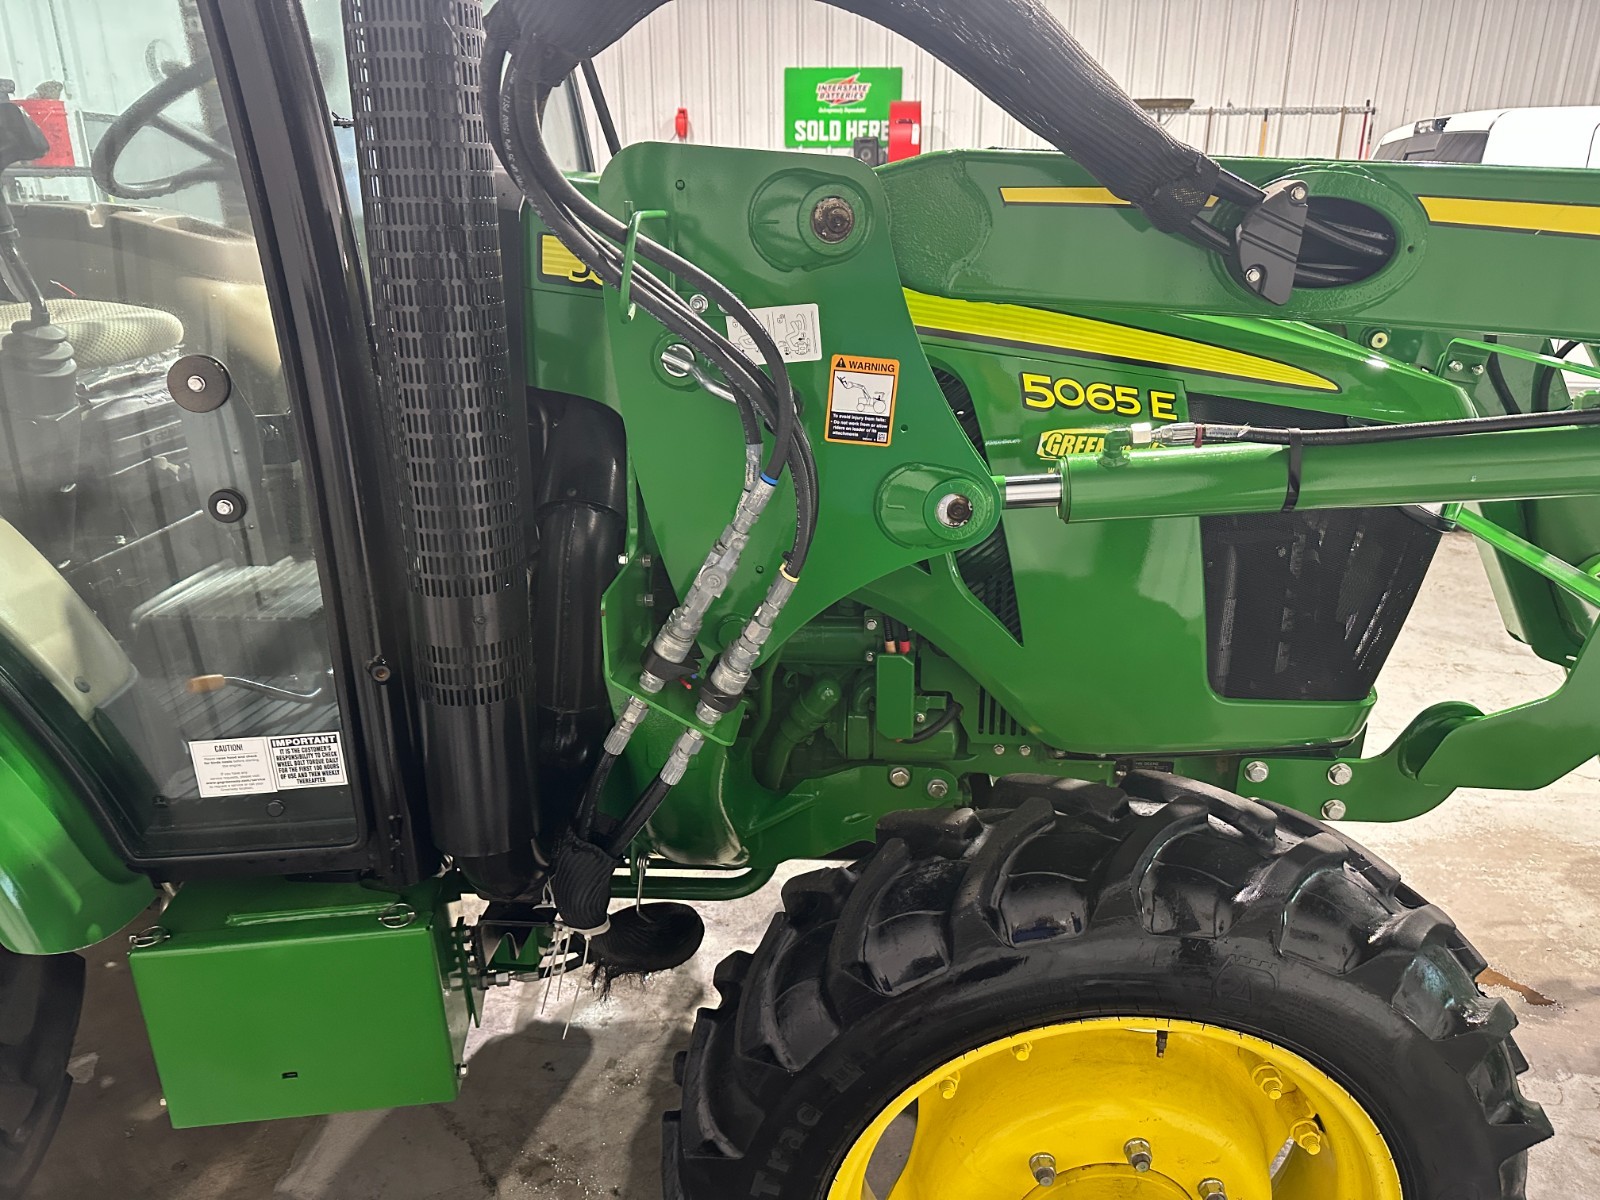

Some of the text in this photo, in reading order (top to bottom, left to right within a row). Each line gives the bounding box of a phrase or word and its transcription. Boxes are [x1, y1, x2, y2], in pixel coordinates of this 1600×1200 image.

[794, 120, 889, 141] SOLD HERE
[849, 361, 895, 372] WARNING
[1021, 372, 1179, 422] 5065 E
[272, 736, 336, 747] IMPORTANT
[214, 744, 244, 752] CAUTION!
